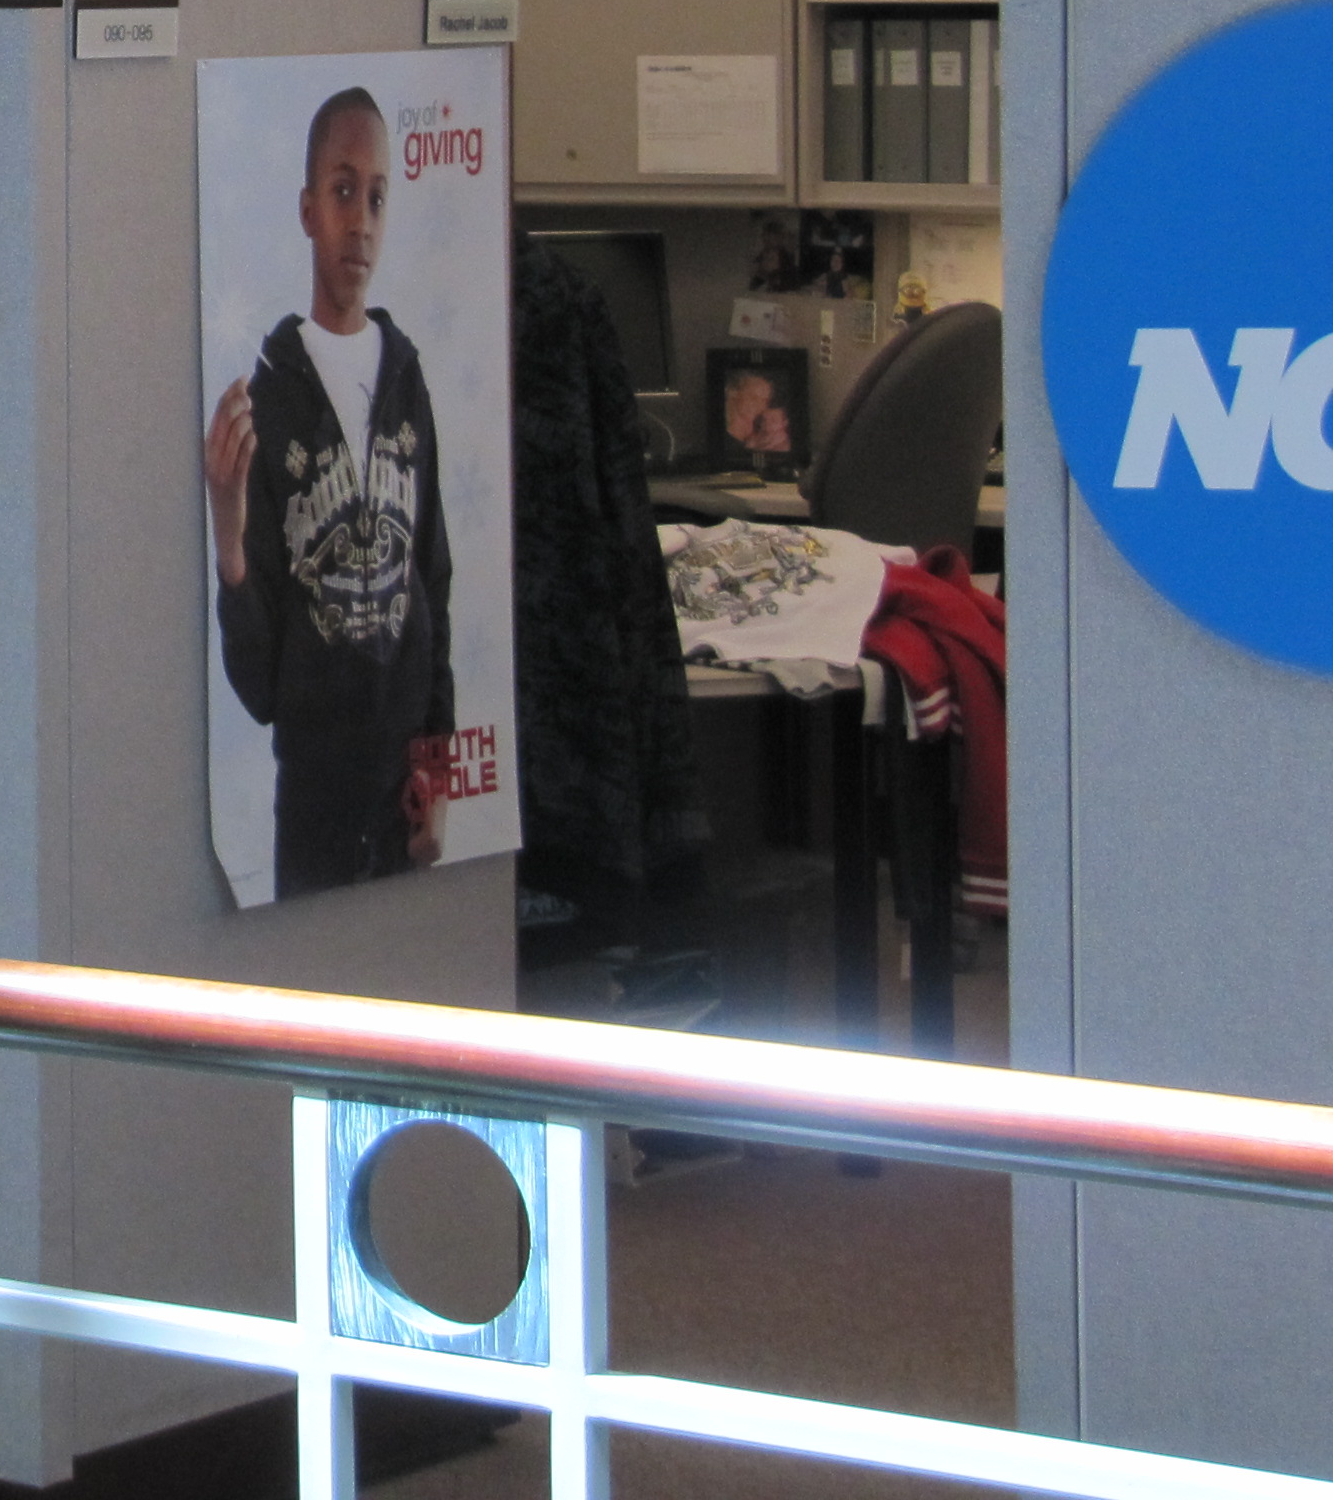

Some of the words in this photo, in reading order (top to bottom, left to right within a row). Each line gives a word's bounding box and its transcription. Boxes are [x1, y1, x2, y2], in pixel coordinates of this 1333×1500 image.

[396, 101, 420, 135] joy
[422, 99, 438, 127] of
[404, 127, 483, 181] giving
